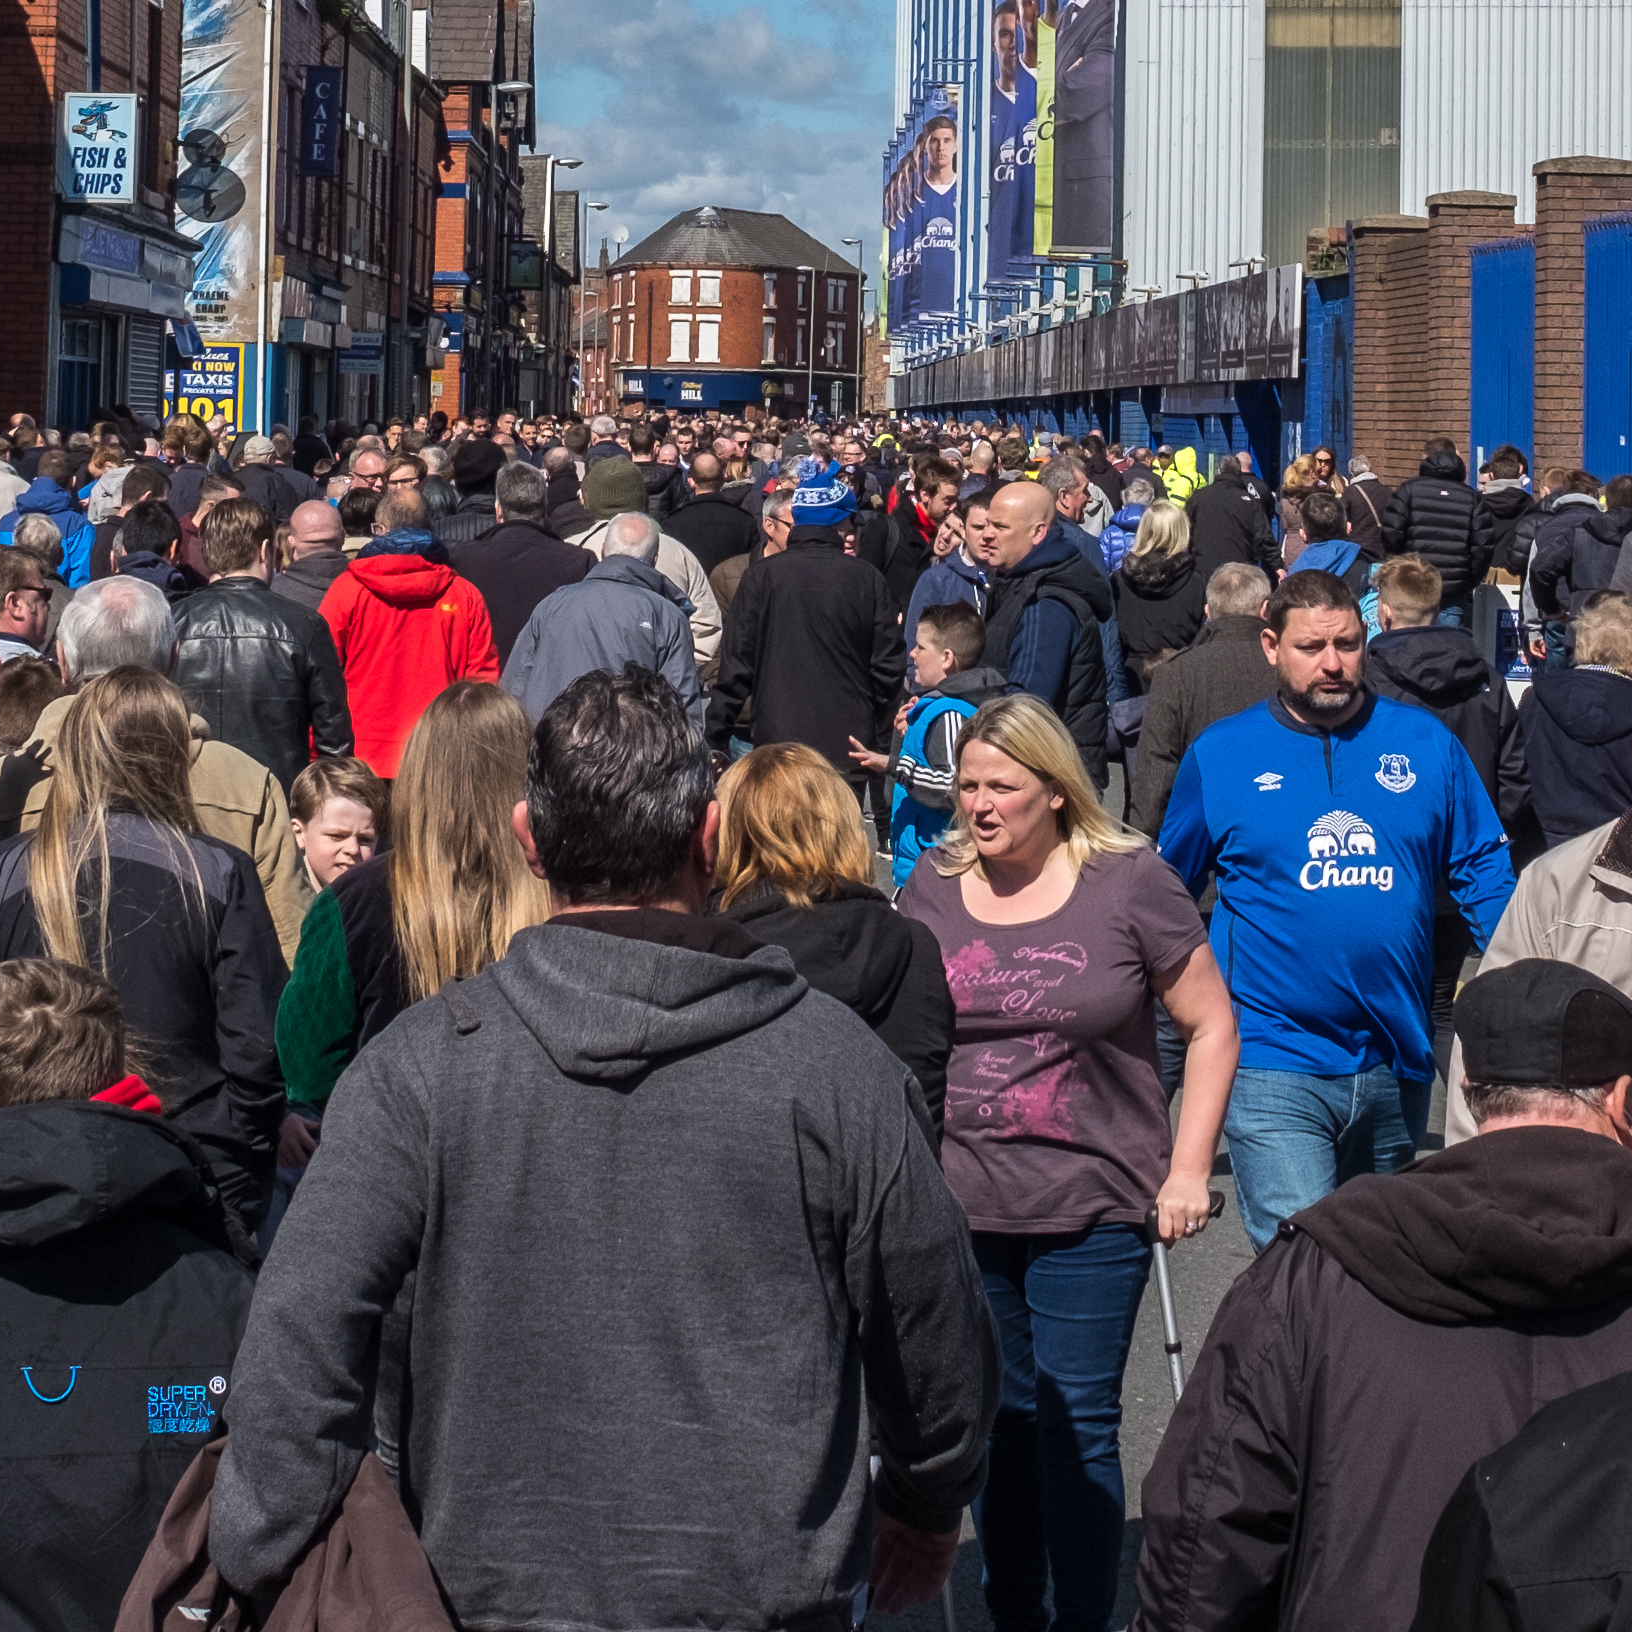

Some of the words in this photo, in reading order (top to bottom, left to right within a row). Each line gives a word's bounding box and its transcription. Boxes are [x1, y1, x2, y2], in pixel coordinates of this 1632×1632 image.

[311, 81, 331, 161] CAFE
[71, 147, 110, 169] FISH
[113, 148, 127, 169] &
[72, 172, 122, 195] CHIPS
[206, 361, 235, 372] NOW
[183, 373, 233, 386] TAXIS
[1299, 859, 1394, 892] Chang
[147, 1385, 206, 1402] SUPER
